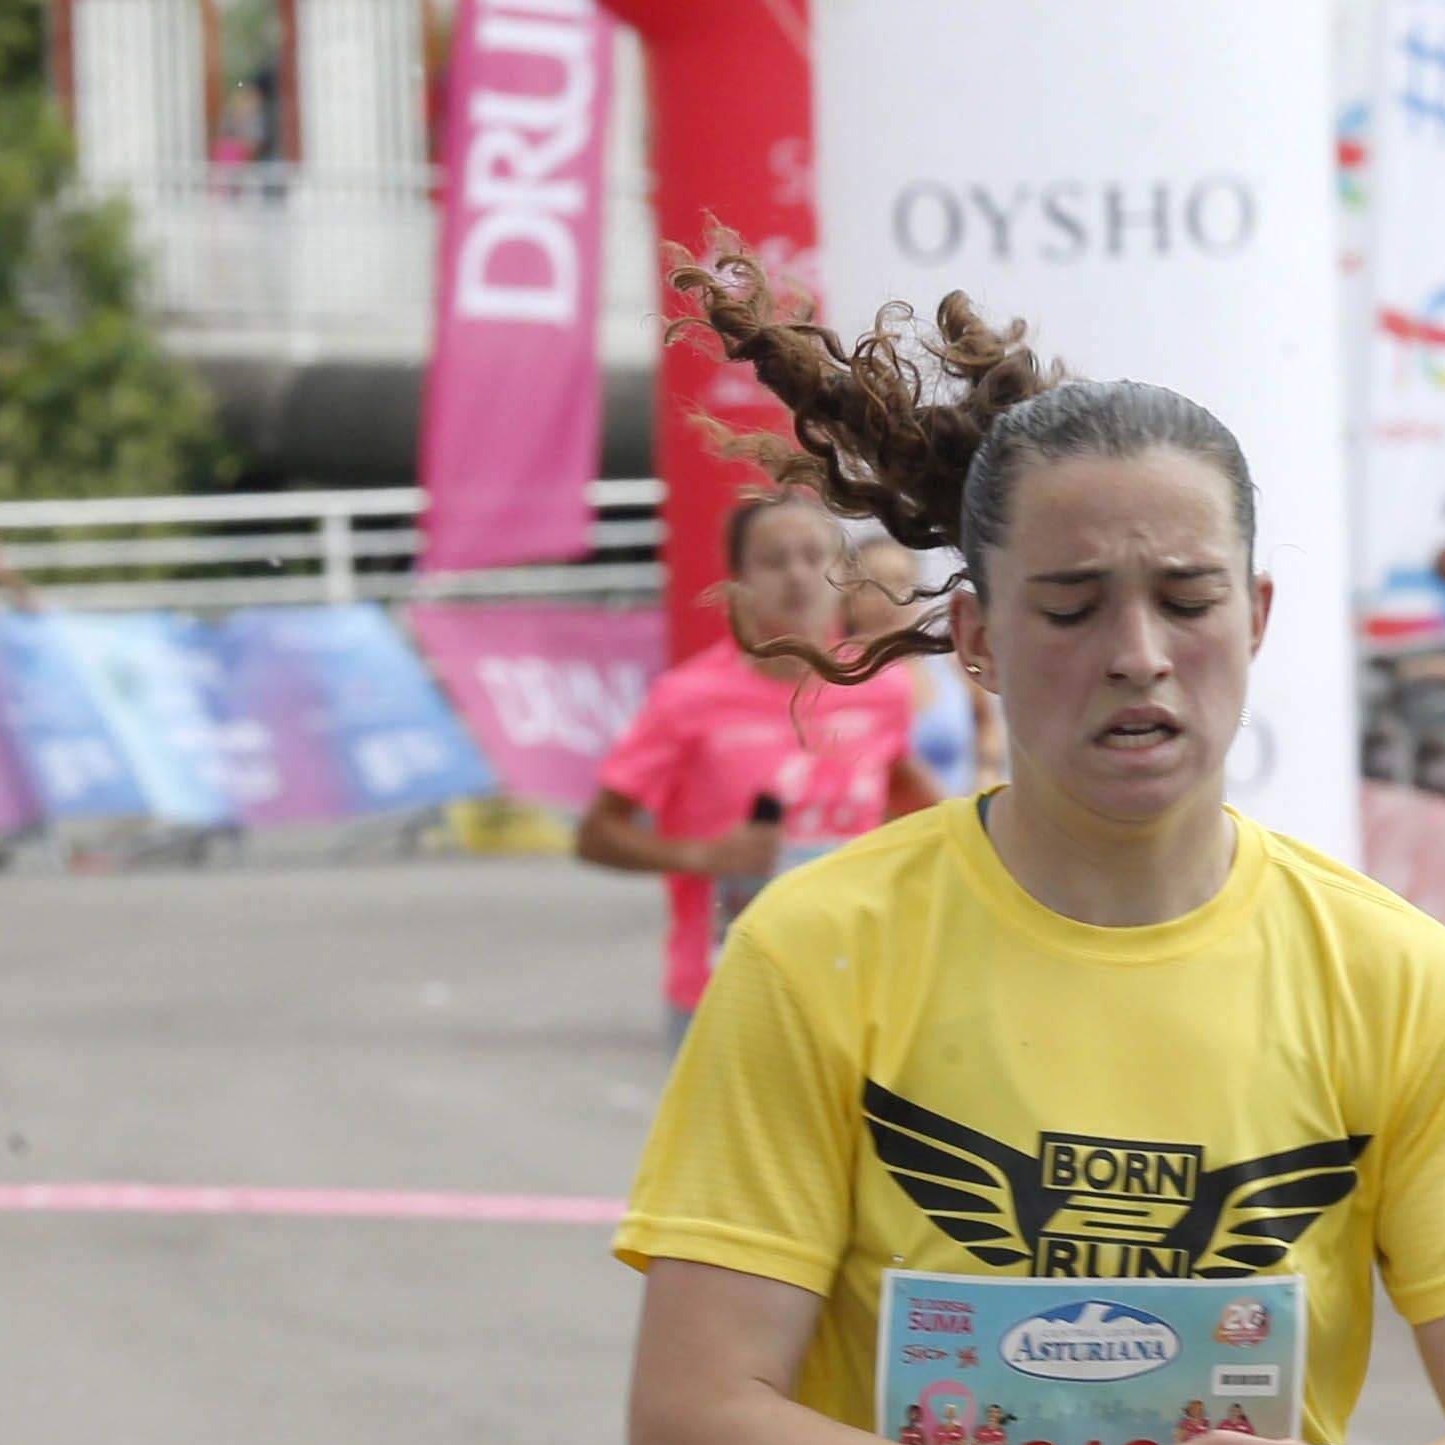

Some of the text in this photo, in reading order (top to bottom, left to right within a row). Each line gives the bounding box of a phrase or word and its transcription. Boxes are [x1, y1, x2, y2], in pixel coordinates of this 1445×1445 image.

[892, 175, 1259, 264] OYSHO
[1052, 1145, 1189, 1198] BORN
[1046, 1239, 1183, 1278] RUN
[1012, 1332, 1169, 1362] ASTURIANA
